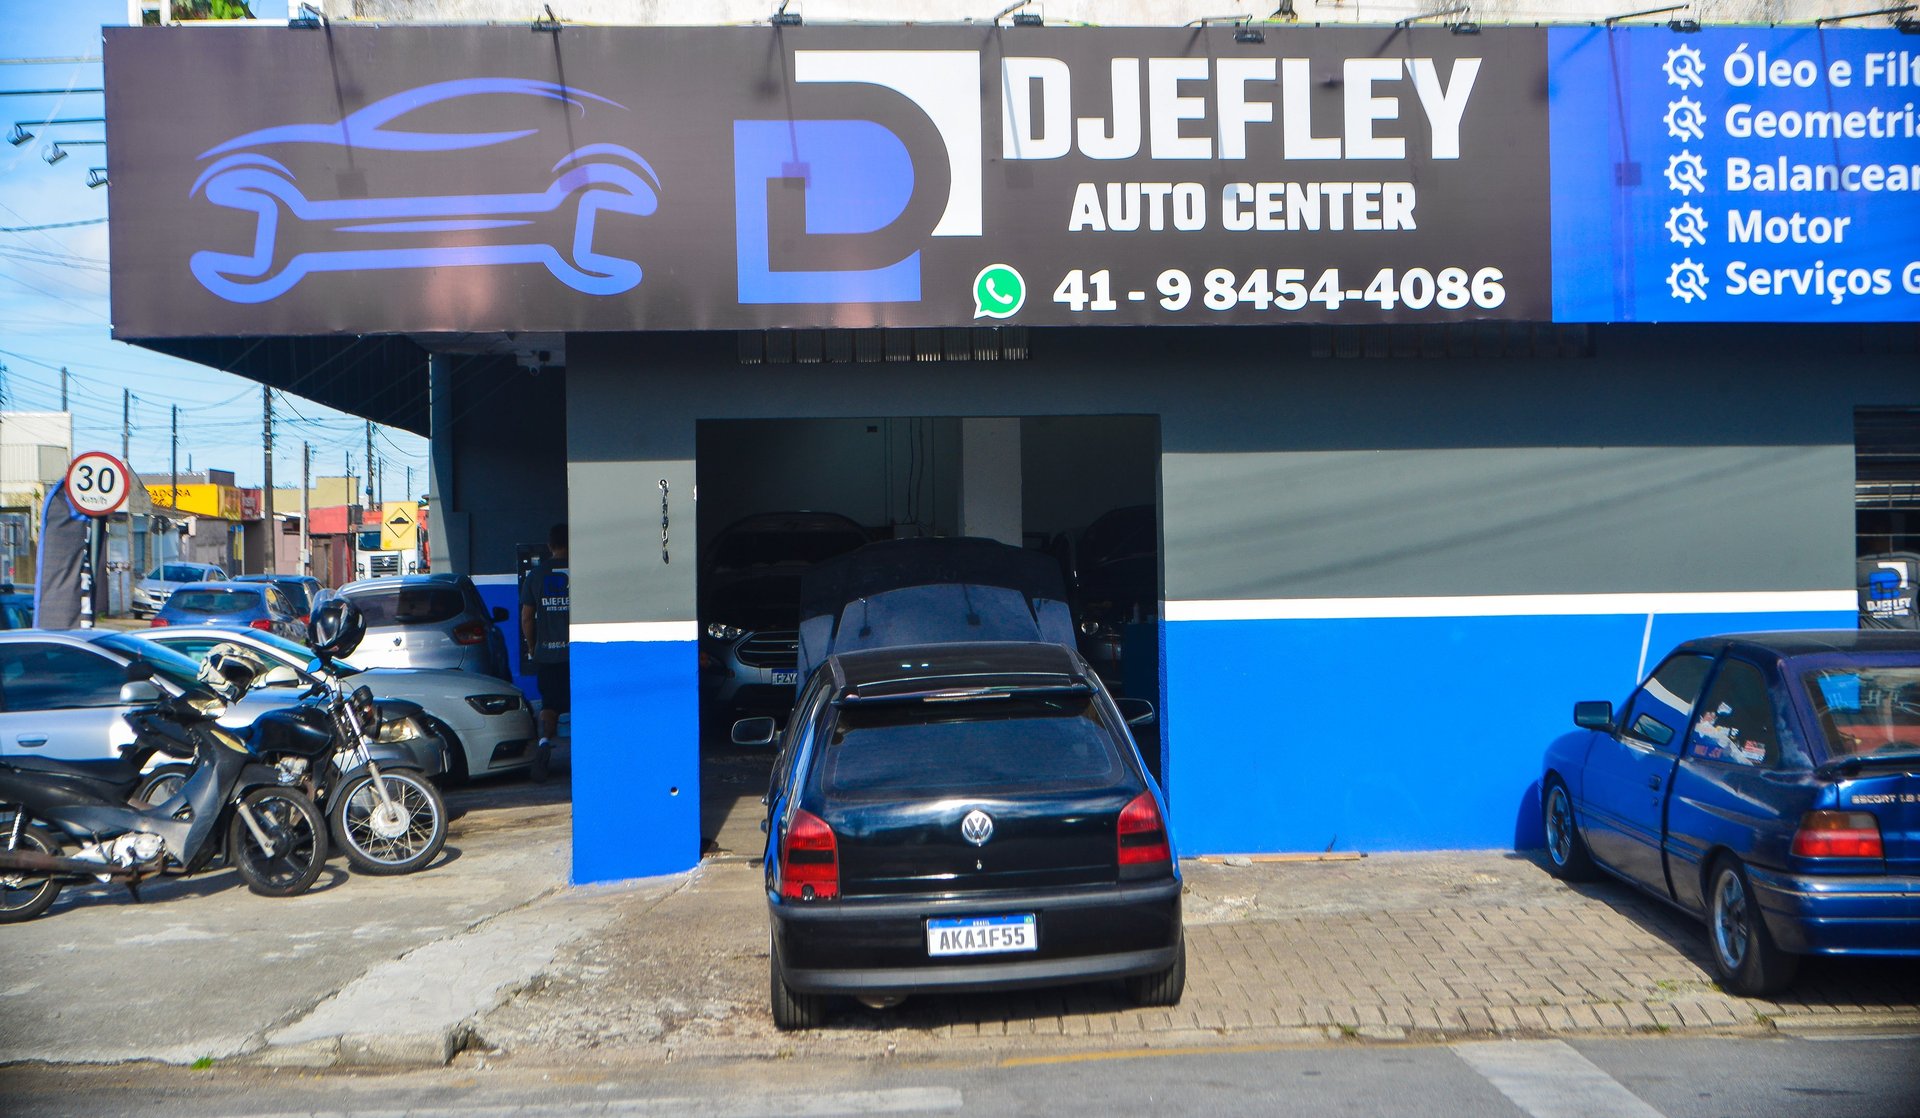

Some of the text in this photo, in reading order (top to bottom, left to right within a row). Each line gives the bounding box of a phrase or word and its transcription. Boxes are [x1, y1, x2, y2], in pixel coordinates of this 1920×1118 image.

[1723, 43, 1818, 88] Óleo
[1828, 60, 1853, 87] e
[1001, 56, 1483, 160] DJEFLEY
[1725, 102, 1920, 139] Geometri
[1068, 182, 1417, 232] AUTO CENTER
[1727, 209, 1851, 244] Motor
[1053, 269, 1117, 311] 41
[1726, 260, 1892, 306] Serviços
[76, 465, 115, 494] 30
[776, 673, 796, 684] FZY
[1851, 794, 1896, 805] ESCORT
[940, 926, 1025, 951] AKA1F55
